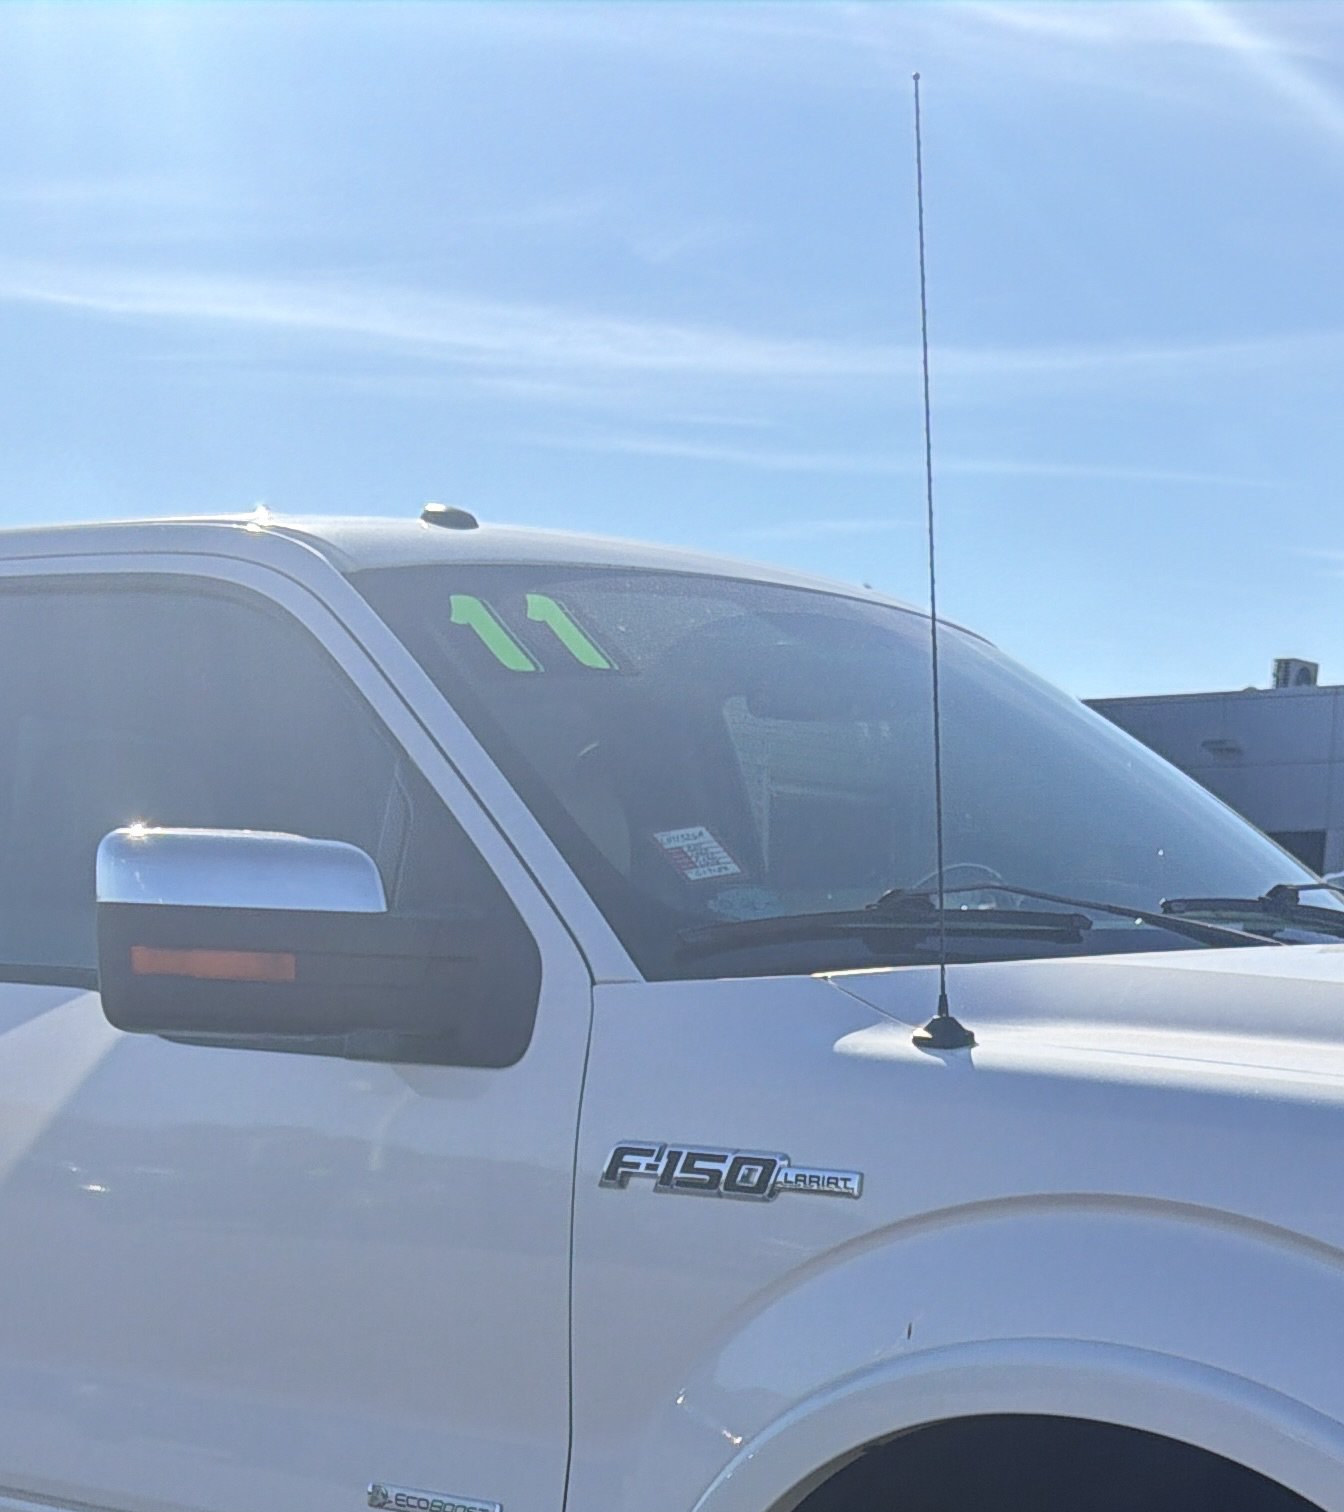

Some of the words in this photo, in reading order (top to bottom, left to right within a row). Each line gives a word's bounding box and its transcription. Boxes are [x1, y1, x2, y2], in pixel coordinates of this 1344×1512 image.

[448, 592, 618, 672] 11
[602, 1144, 786, 1199] F-150
[783, 1171, 853, 1192] LARIAT
